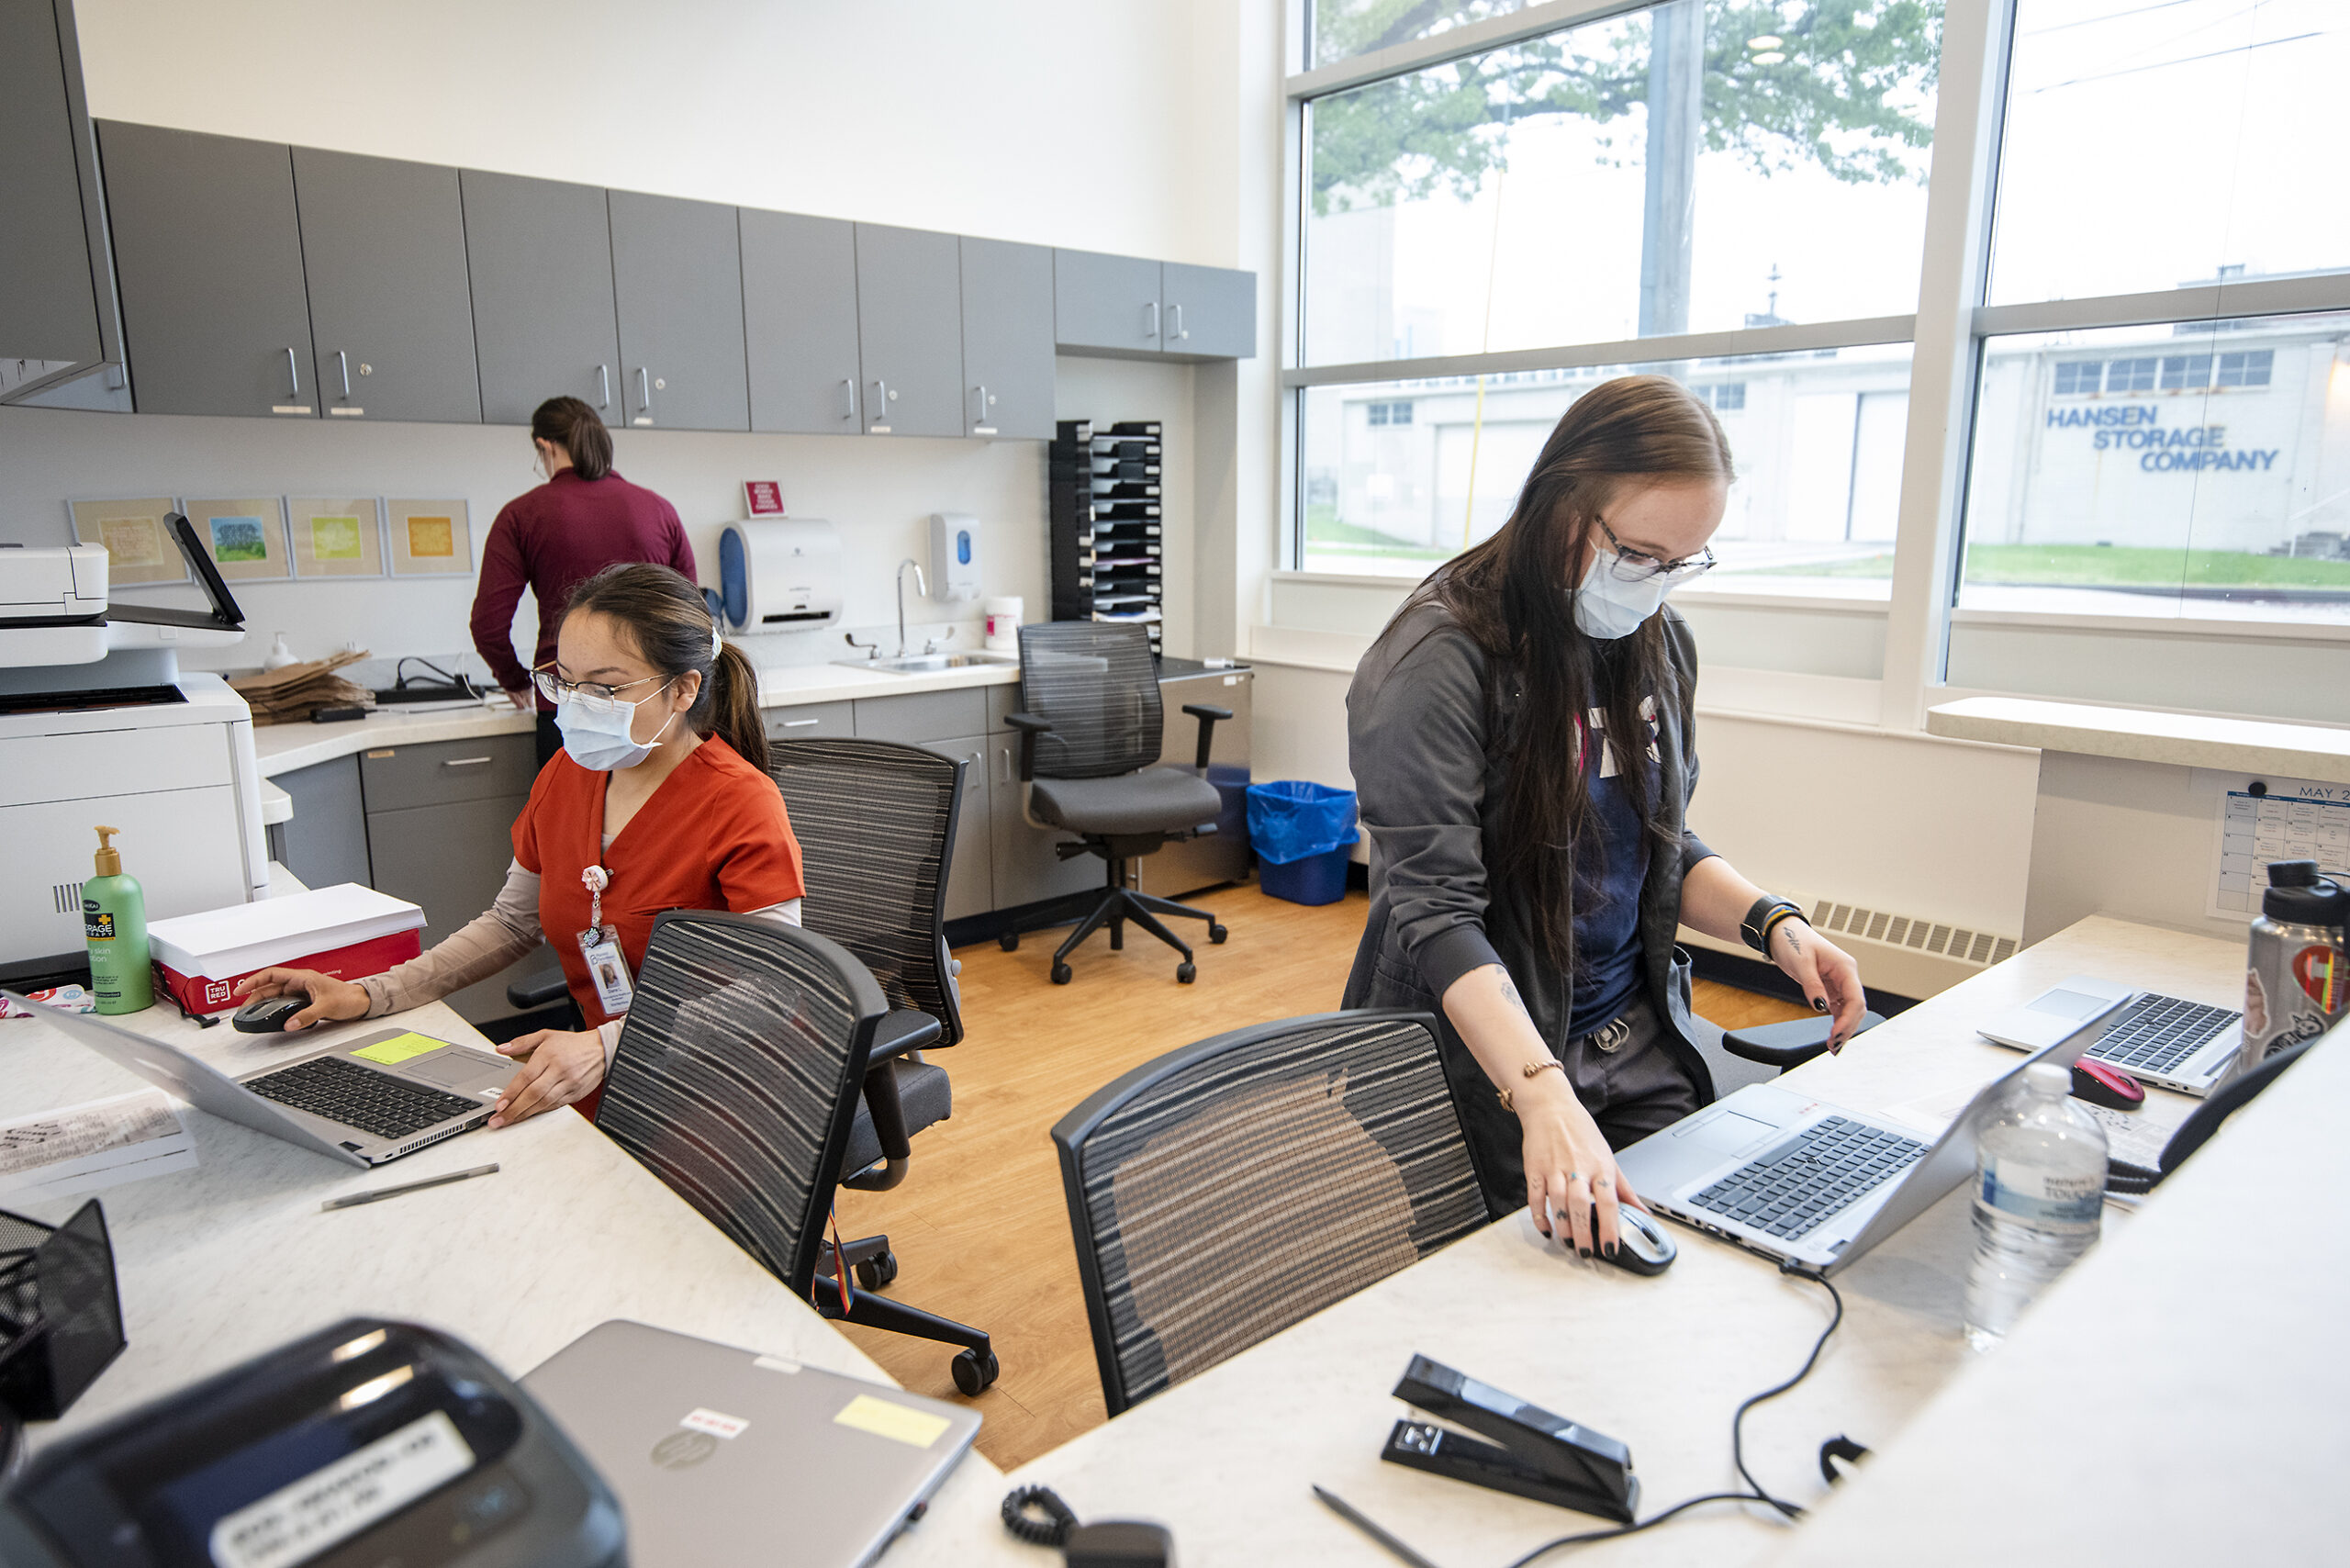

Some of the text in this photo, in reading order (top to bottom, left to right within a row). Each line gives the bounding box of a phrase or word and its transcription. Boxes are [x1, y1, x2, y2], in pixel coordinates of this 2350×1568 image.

[2047, 406, 2157, 428] HANSEN
[2093, 426, 2227, 450] STORAGE
[2141, 450, 2279, 472] COMPANY
[2300, 787, 2350, 801] MAY 2
[84, 924, 113, 933] RAGE
